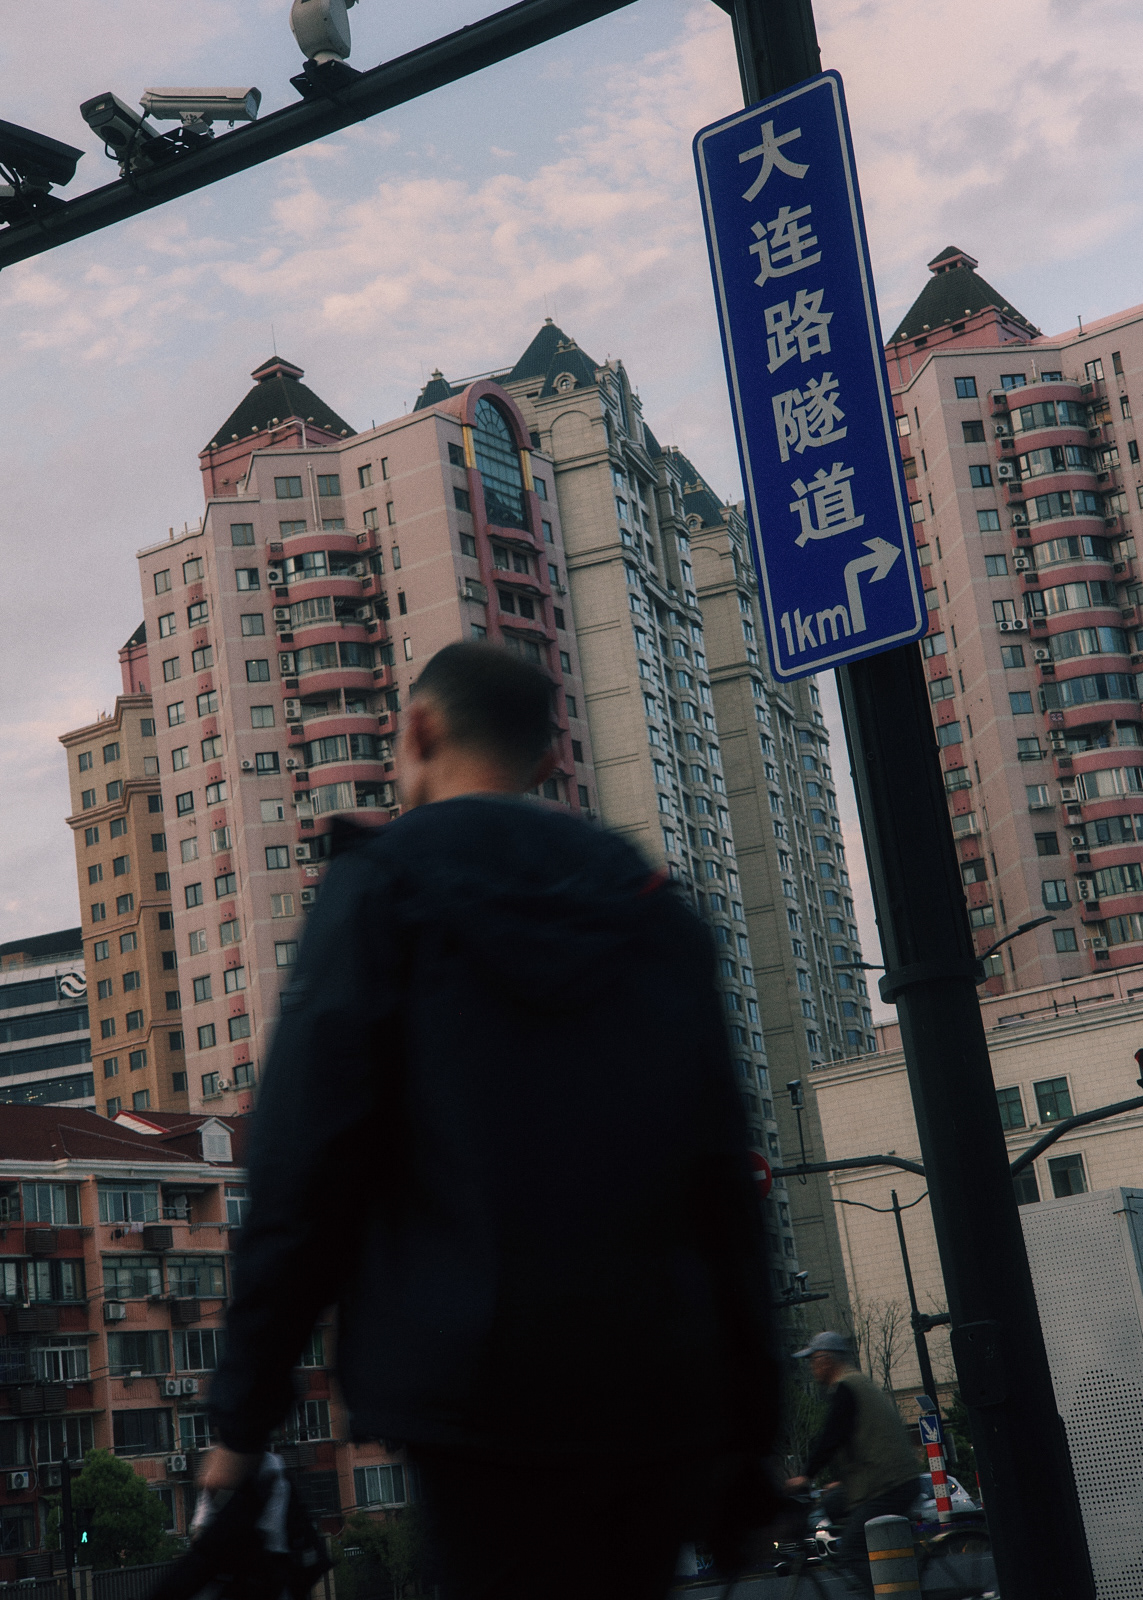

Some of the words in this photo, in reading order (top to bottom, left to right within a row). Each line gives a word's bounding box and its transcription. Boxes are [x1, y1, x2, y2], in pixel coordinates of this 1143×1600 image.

[738, 120, 865, 548] 大连路隧道
[780, 604, 851, 657] 1km
